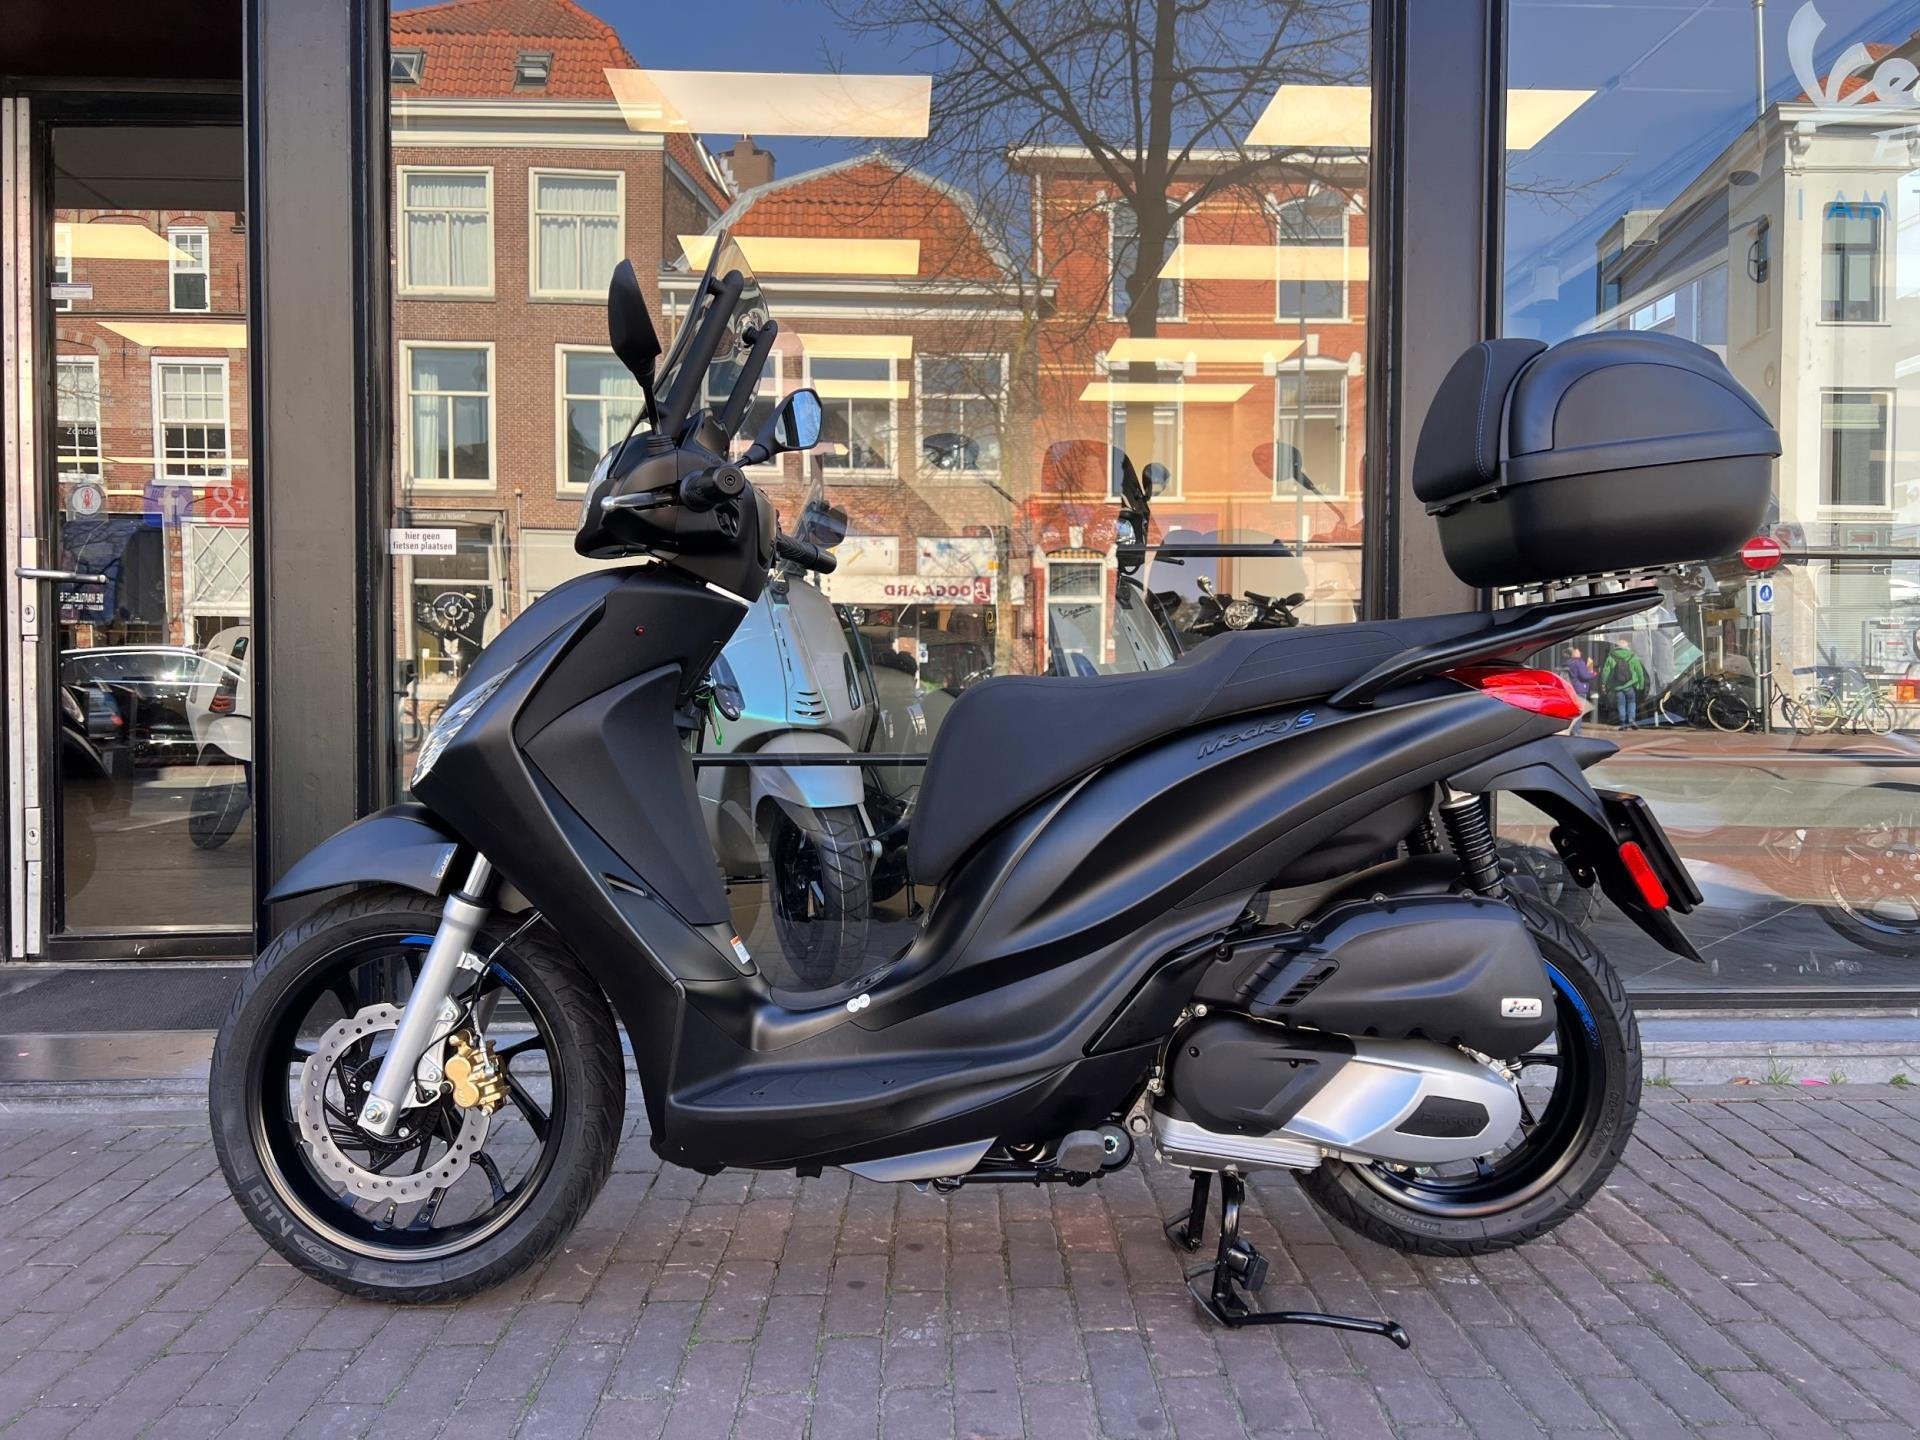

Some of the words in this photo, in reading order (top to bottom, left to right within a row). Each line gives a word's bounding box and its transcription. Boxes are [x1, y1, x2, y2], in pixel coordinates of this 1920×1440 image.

[1787, 0, 1920, 112] Ve
[393, 541, 419, 550] fietsen
[420, 541, 453, 552] plaatsen
[405, 531, 420, 540] hier
[422, 533, 440, 542] geen
[1197, 709, 1310, 760] Medley
[248, 1186, 295, 1238] CITY
[1385, 1207, 1441, 1231] MICHELIN
